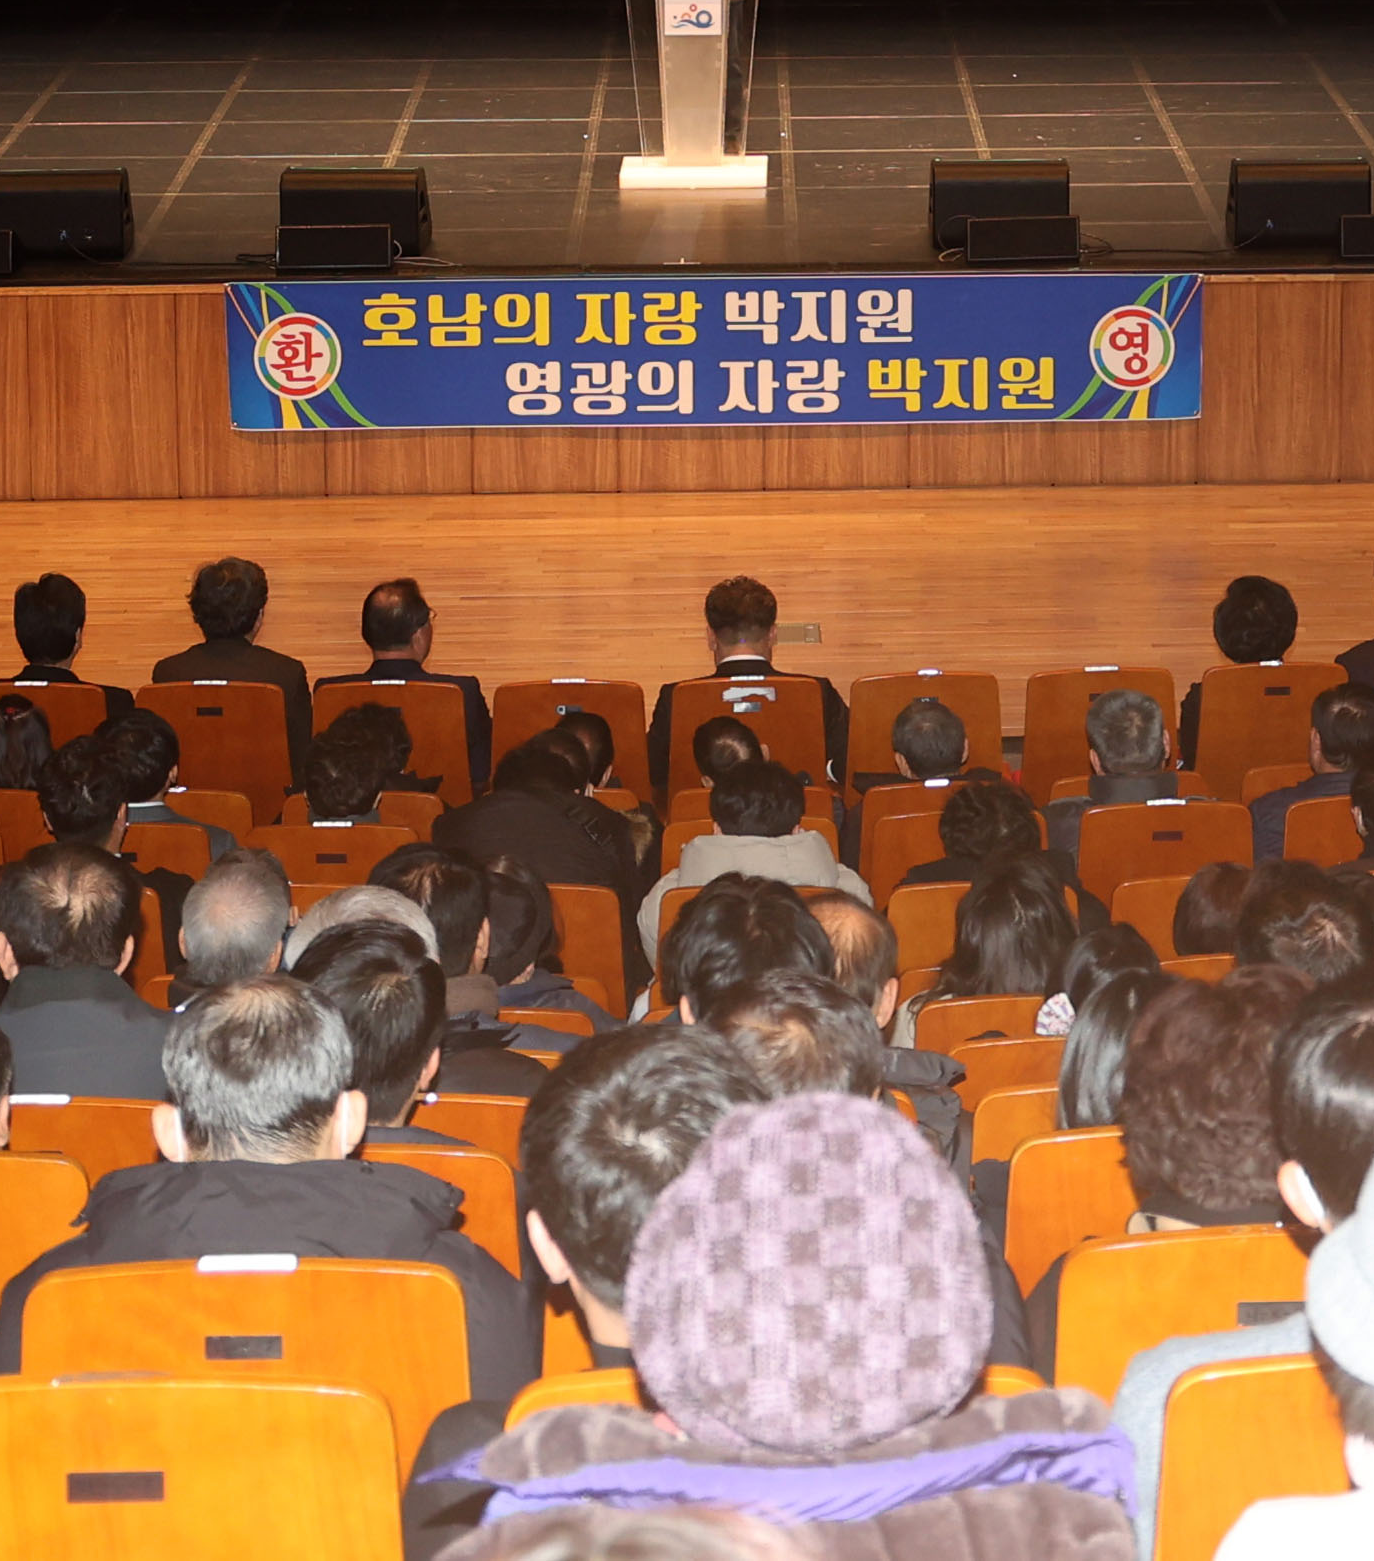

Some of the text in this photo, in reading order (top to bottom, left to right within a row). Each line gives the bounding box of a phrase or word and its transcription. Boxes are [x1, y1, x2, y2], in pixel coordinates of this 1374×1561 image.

[361, 287, 914, 348] 호남의 자랑 박지원
[269, 331, 324, 382] 환
[1109, 322, 1149, 374] 영
[504, 355, 1057, 417] 영광의 자랑 박지원
